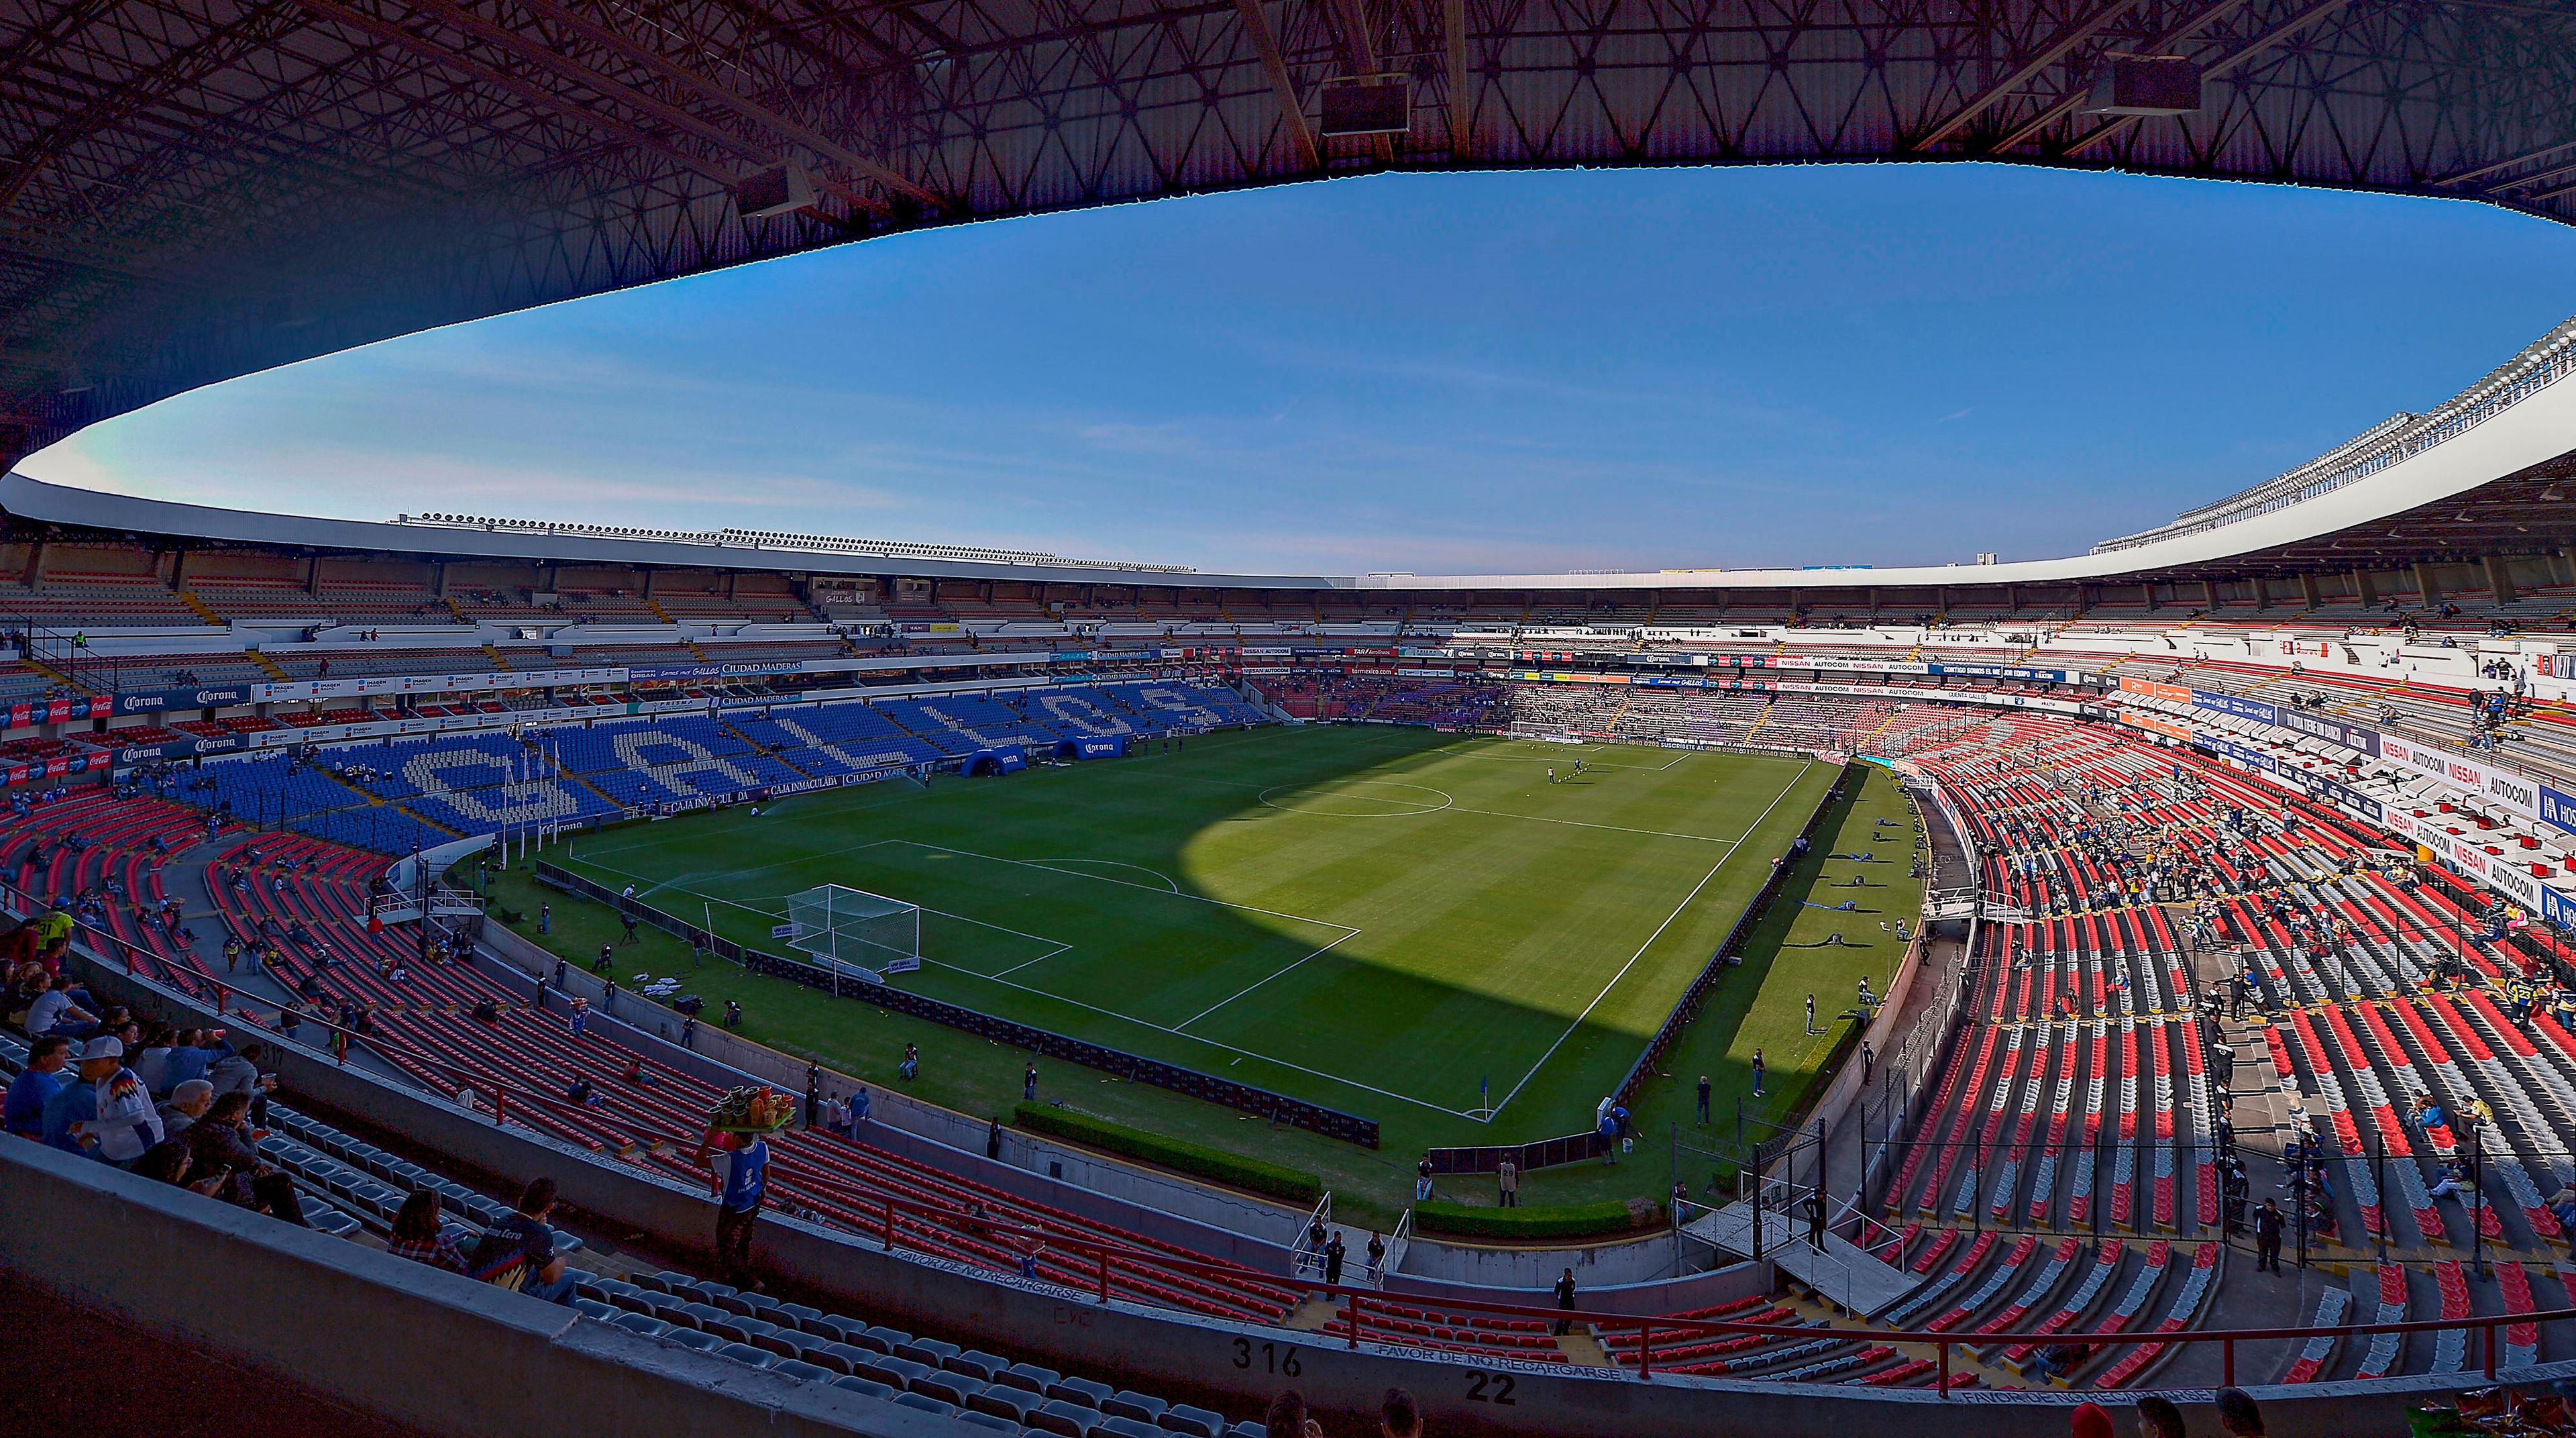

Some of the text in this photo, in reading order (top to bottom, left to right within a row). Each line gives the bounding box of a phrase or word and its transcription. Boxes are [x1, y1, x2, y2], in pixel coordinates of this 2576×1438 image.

[826, 595, 853, 603] GALLOS
[1646, 655, 1670, 663] Corona
[693, 667, 720, 676] GALLOS
[722, 662, 800, 674] CIUDAD MADERAS
[1681, 678, 1703, 686] GALLOS
[124, 696, 164, 711] Corona
[197, 690, 238, 705] Corona
[722, 697, 753, 705] CIUDAD
[755, 695, 788, 703] MADERAS
[195, 738, 235, 752] Corona
[1085, 743, 1114, 754] Corona
[1660, 742, 1697, 750] SUSCRIBETE
[122, 748, 162, 762] Corona
[1819, 752, 1847, 766] GONHER
[845, 764, 920, 784] CIUDAD MADES
[2383, 740, 2533, 809] NISSAN AUTOCOM NISSAN AUTOCOM
[771, 776, 838, 796] CAJA INMACULADA
[671, 797, 694, 813] CAJA
[2387, 810, 2534, 903] NISSAN AUTOCOM NISSAN AUTOCOM
[38, 923, 52, 935] 31
[2518, 989, 2532, 1000] 23
[262, 1042, 283, 1066] 317
[896, 1250, 1085, 1302] FAVOR DE NO RECARGARSE
[1232, 1337, 1301, 1378] 316
[1377, 1344, 1621, 1381] FAVOR DE NO RECARGARSE
[1464, 1370, 1517, 1406] 22
[1962, 1392, 2025, 1404] FAVOR
[2025, 1392, 2053, 1403] DE
[2054, 1392, 2084, 1404] NO
